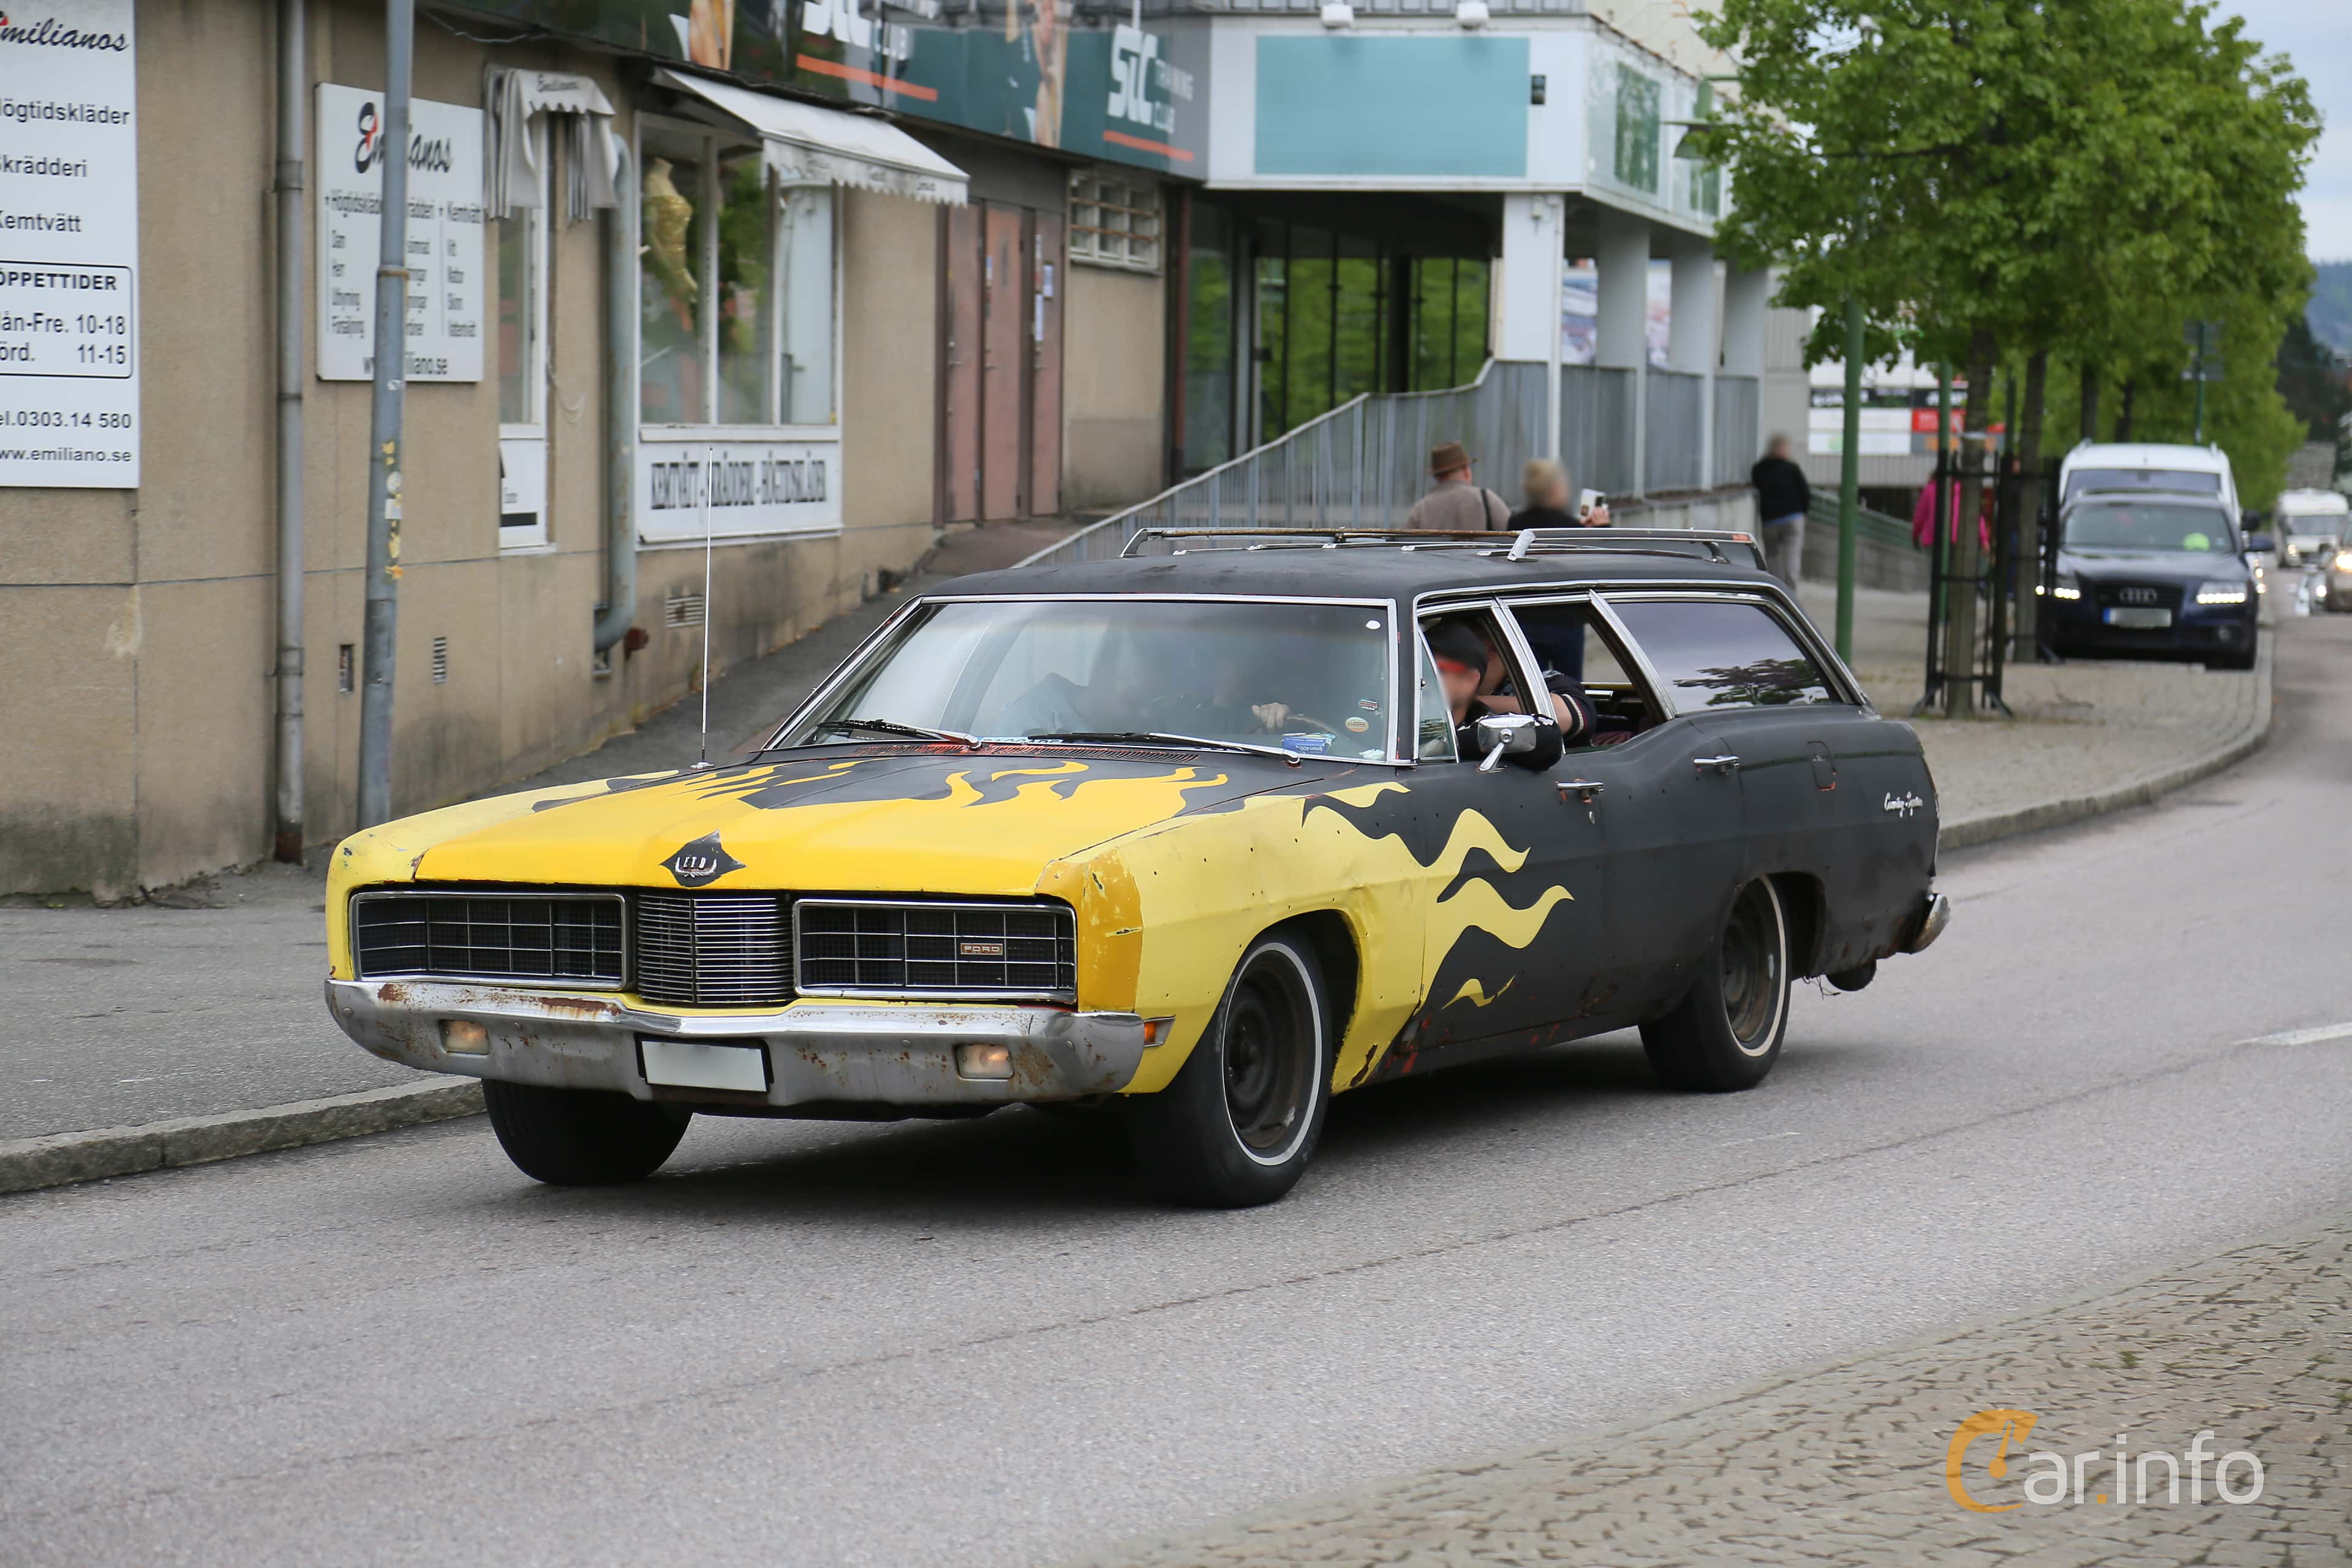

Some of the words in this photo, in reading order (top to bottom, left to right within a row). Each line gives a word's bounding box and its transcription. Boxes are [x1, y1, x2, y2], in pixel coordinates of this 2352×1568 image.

[0, 10, 129, 52] milianos
[0, 98, 131, 125] ögtidskläder
[0, 154, 88, 177] krädderi
[0, 311, 69, 333] ån-Fre.
[76, 314, 126, 335] 10-18
[77, 344, 126, 364] 11-15
[98, 413, 132, 428] 580
